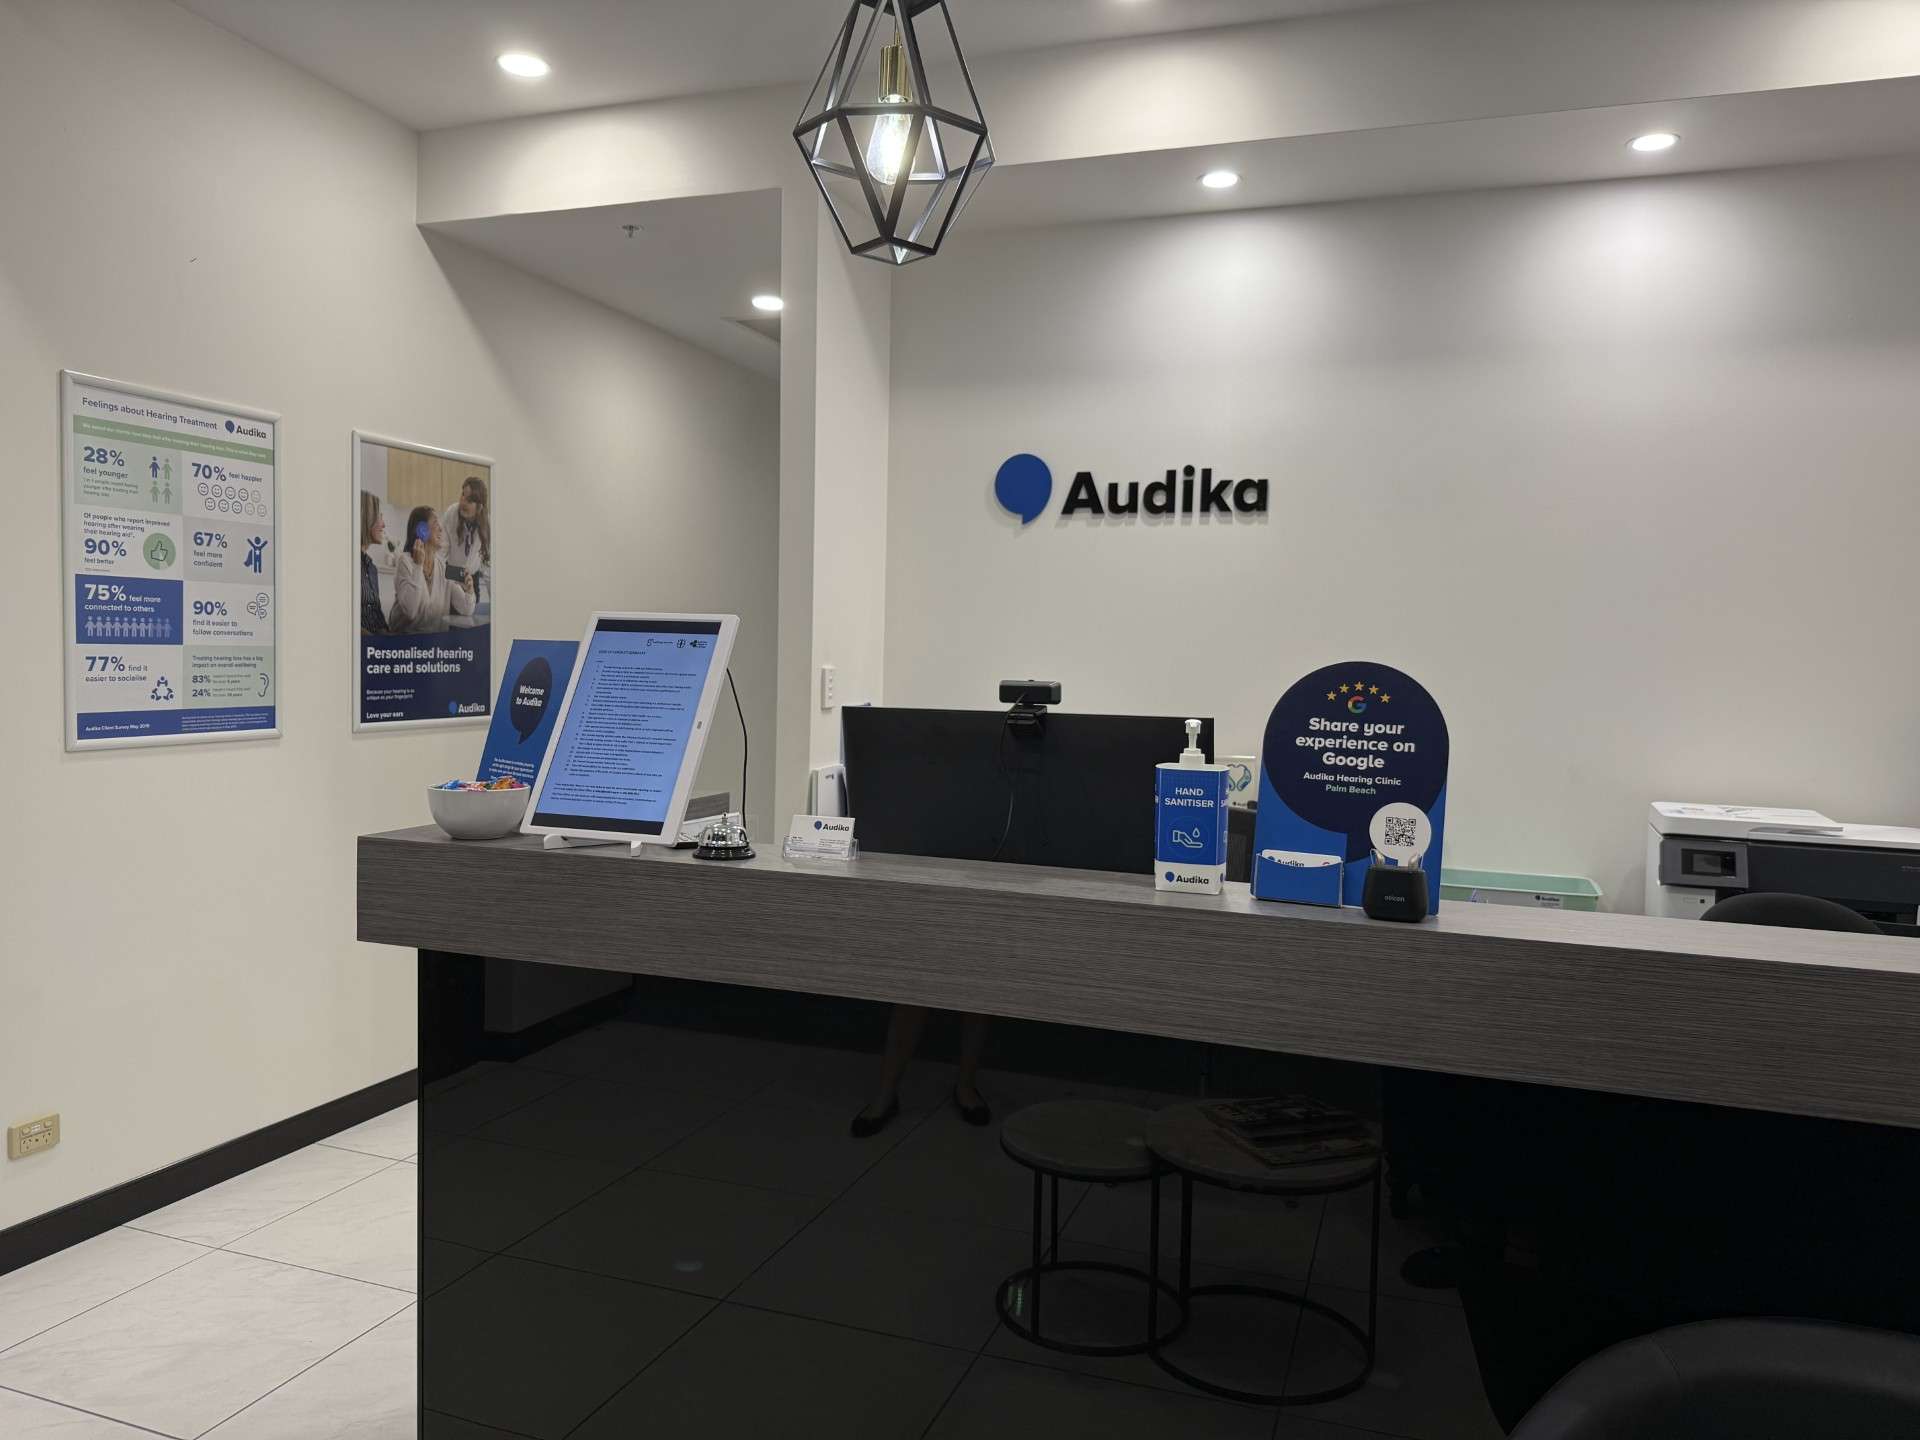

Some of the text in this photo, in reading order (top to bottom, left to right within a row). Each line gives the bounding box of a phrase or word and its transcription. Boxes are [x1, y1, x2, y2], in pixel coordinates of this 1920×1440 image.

[82, 397, 217, 429] Feelings about Hearing Treatment
[236, 425, 267, 438] Audika
[83, 446, 125, 466] 28%
[83, 466, 128, 479] feel younger
[191, 462, 227, 481] 70%
[1061, 464, 1269, 516] Audika
[83, 520, 106, 528] hearing
[122, 524, 144, 532] wearing
[127, 517, 144, 525] report
[98, 529, 121, 538] hearing
[193, 531, 228, 549] 67%
[84, 537, 127, 556] 90%
[193, 560, 223, 568] confident
[84, 583, 127, 601] 75%
[84, 603, 122, 611] connected
[193, 600, 227, 616] 90%
[366, 646, 474, 661] Personalised hearing
[85, 655, 125, 671] 77%
[366, 660, 461, 673] care and solutions
[192, 674, 211, 683] 83%
[192, 688, 211, 697] 24%
[519, 685, 545, 695] Welcome
[515, 696, 543, 707] to Audika
[458, 703, 486, 714] Audika
[1308, 717, 1405, 736] Share your
[1295, 735, 1416, 753] experience on
[1322, 752, 1385, 770] Google
[1303, 772, 1401, 786] Audika Hearing Clinic
[1175, 787, 1204, 796] HAND
[1325, 784, 1377, 795] Palm Beach
[1164, 797, 1214, 808] SANITISER
[822, 823, 849, 831] Audika
[1176, 874, 1209, 885] Audika
